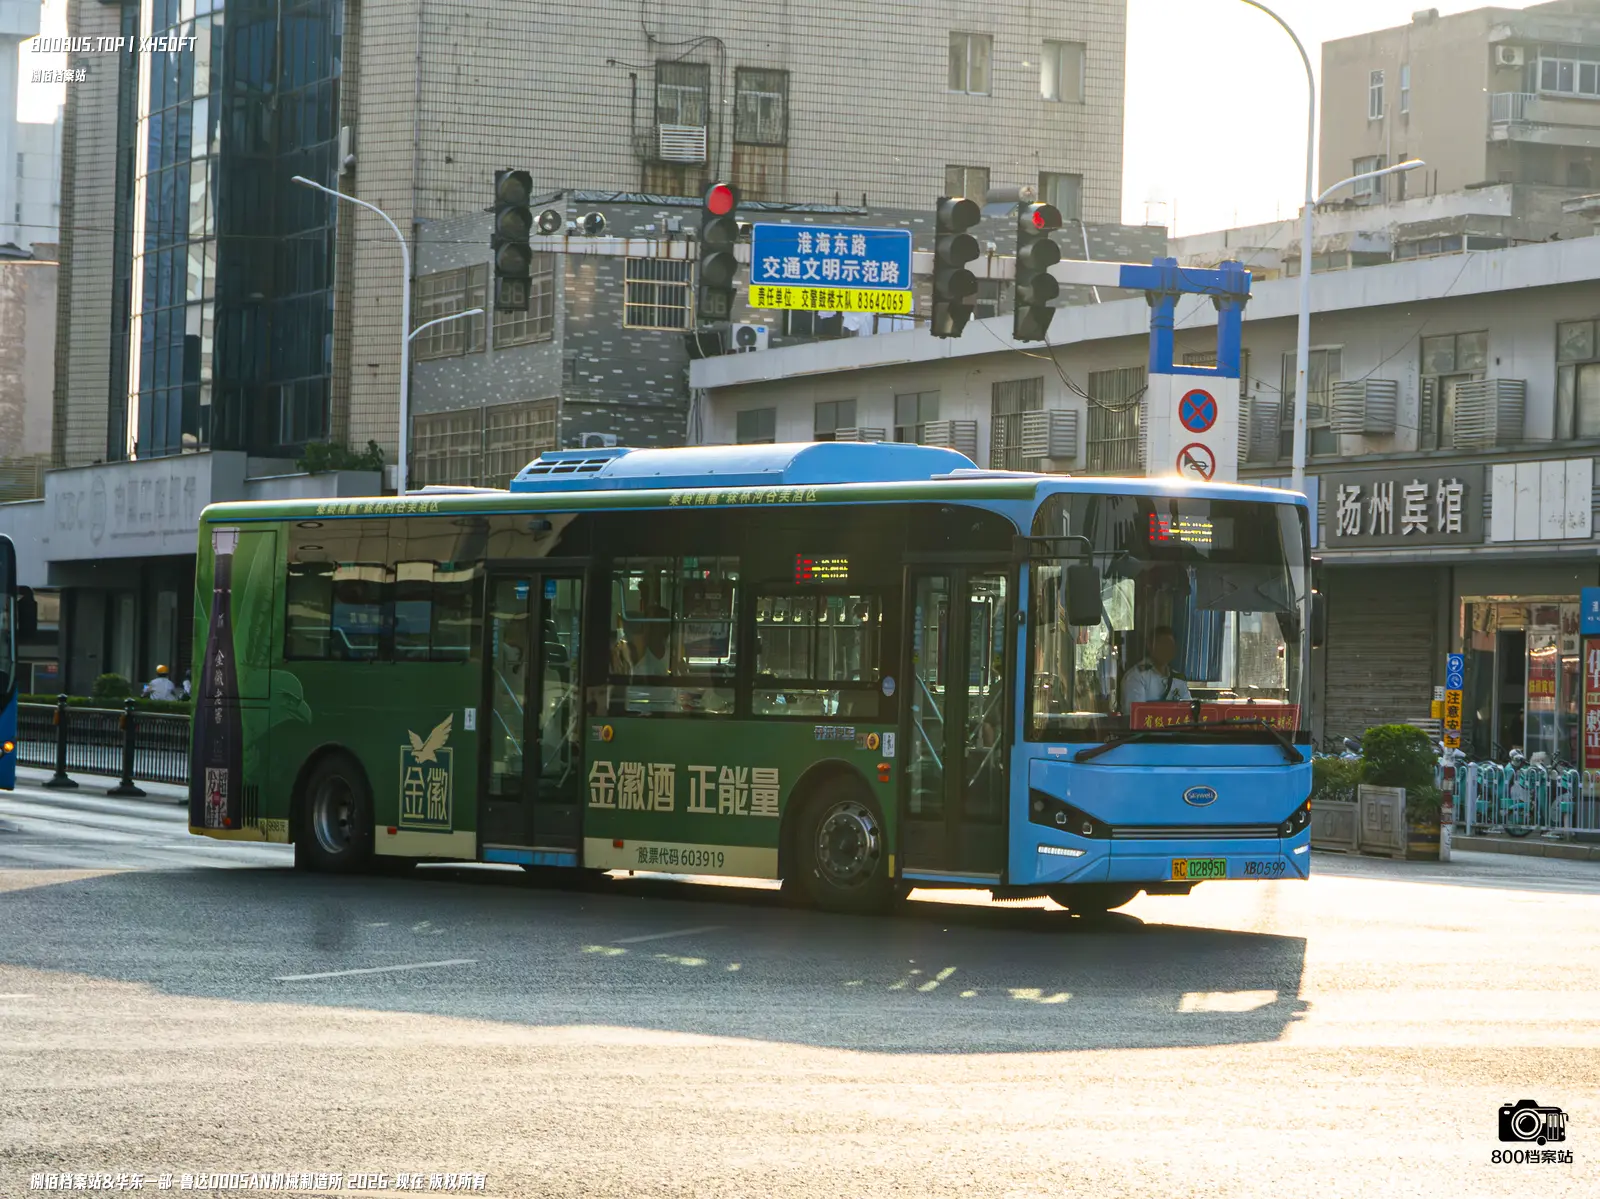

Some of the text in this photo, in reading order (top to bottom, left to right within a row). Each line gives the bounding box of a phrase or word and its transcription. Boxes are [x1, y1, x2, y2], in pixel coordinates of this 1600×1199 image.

[797, 231, 867, 257] 淮海东路
[762, 256, 900, 284] 交通文明示范路
[857, 292, 904, 311] 83642069
[1336, 478, 1464, 537] 扬州宾馆
[404, 767, 448, 820] 金徽
[588, 760, 780, 817] 金徽酒 正能量
[1243, 861, 1286, 876] XB0599
